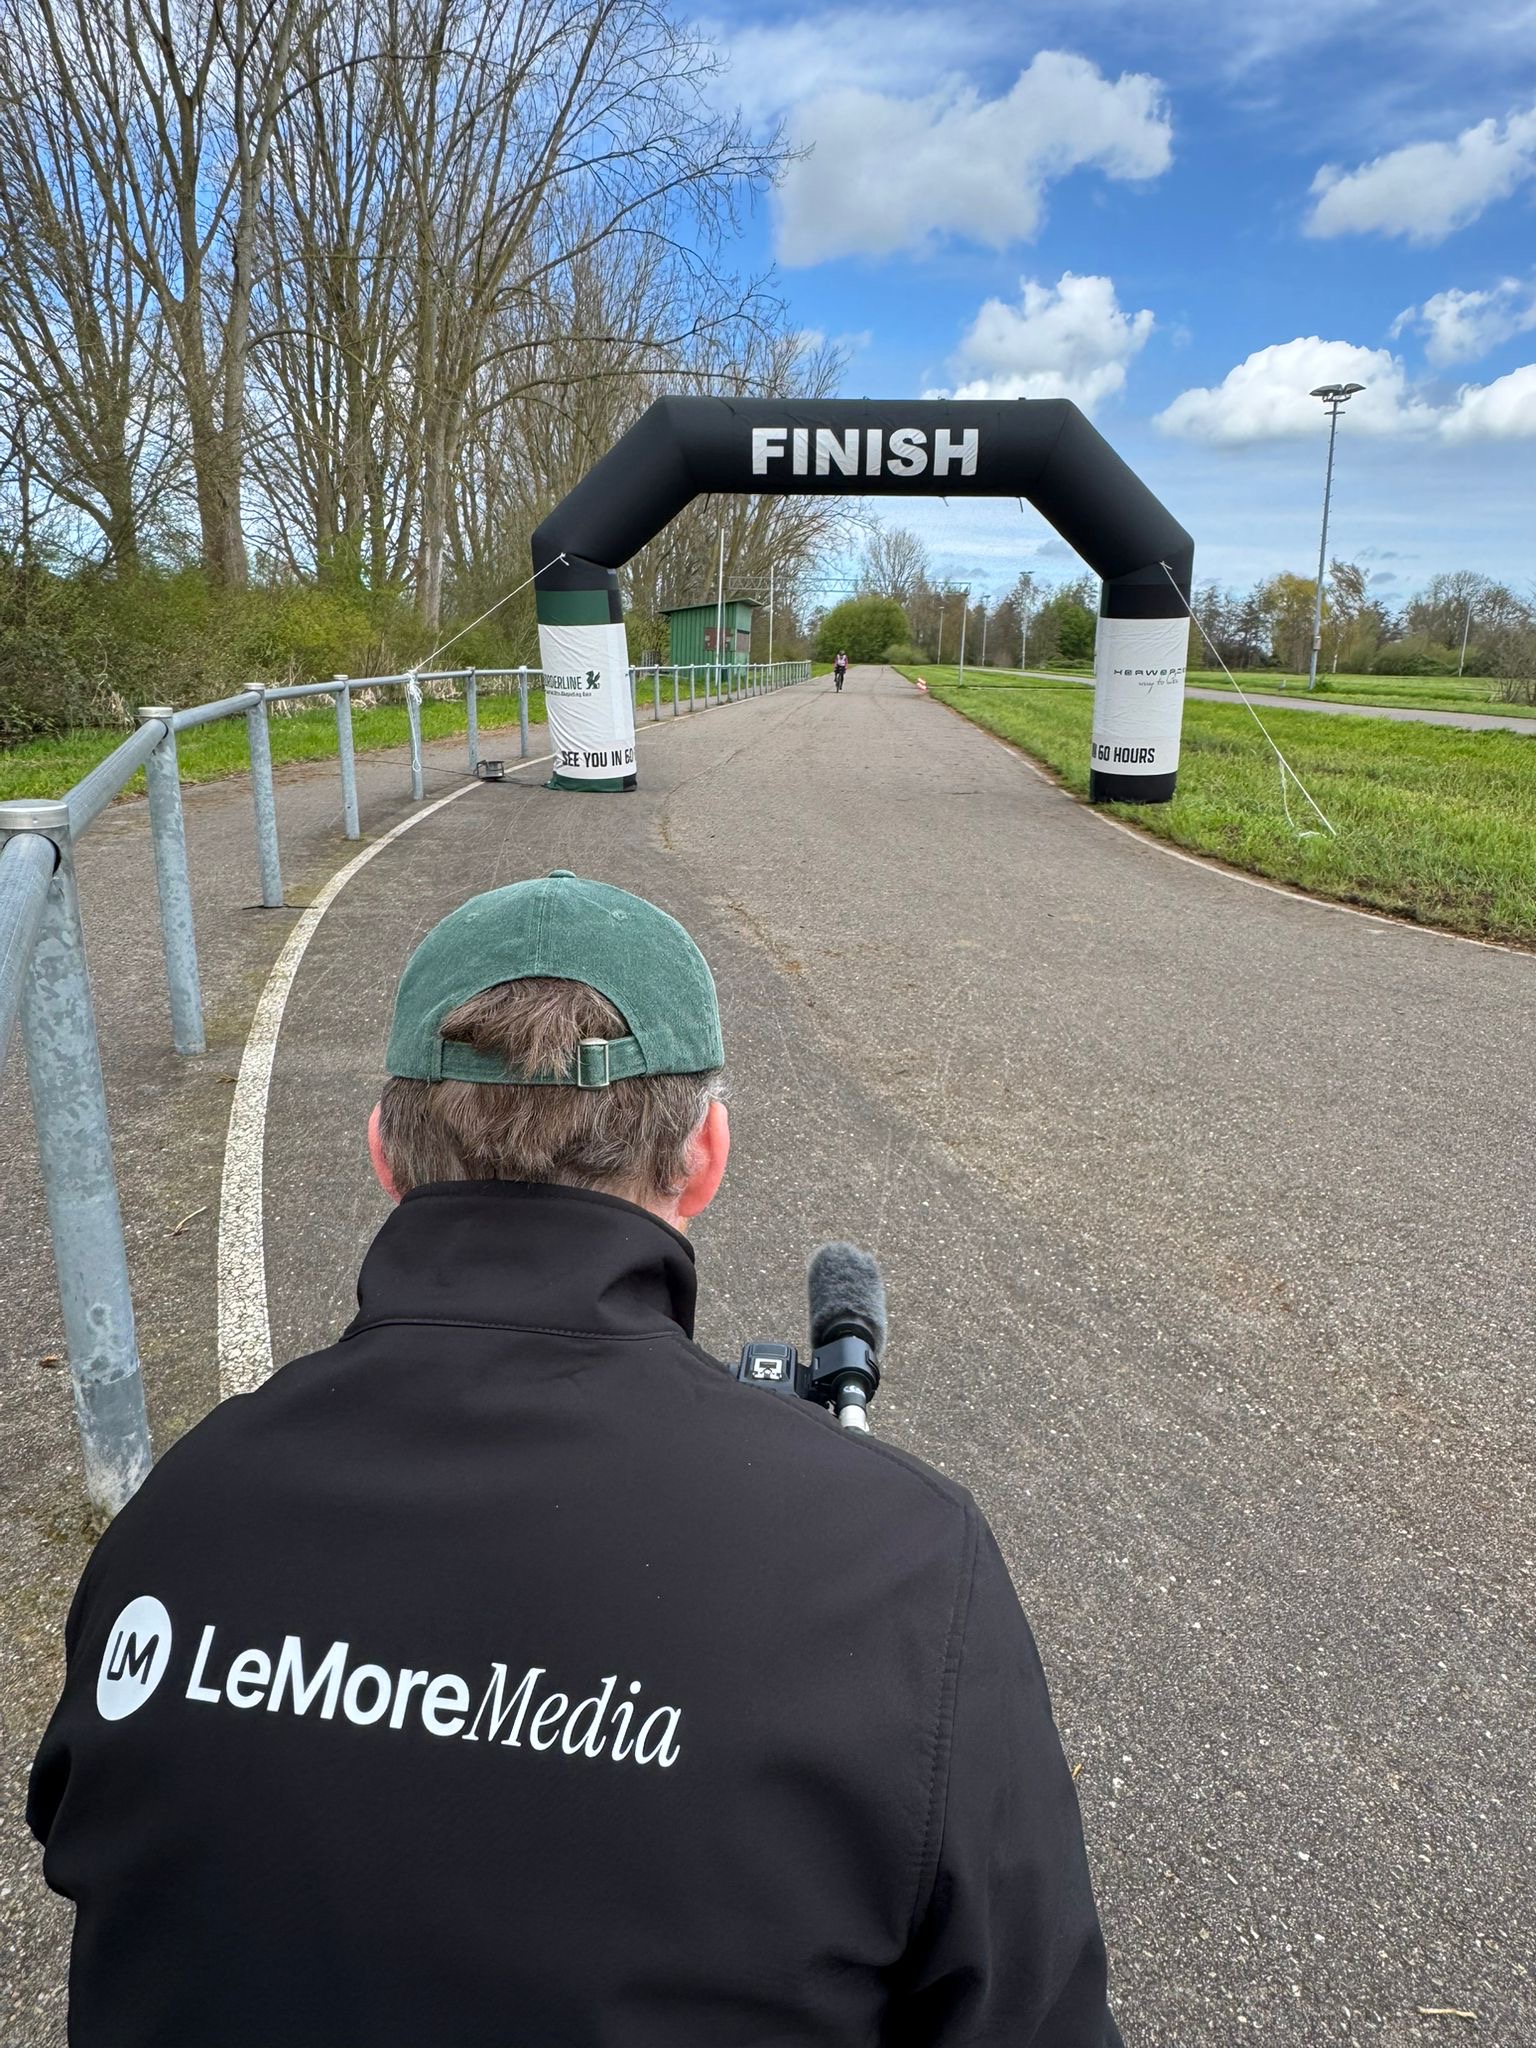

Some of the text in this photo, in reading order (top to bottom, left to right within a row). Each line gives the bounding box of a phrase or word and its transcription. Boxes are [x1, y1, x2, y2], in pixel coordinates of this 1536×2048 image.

[752, 427, 979, 477] FINISH
[561, 750, 580, 767] SEE
[583, 751, 608, 768] YOU
[611, 749, 622, 766] IN
[1098, 744, 1111, 761] 60
[1113, 746, 1155, 764] HOURS
[185, 1624, 682, 1768] LeMoreMedia
